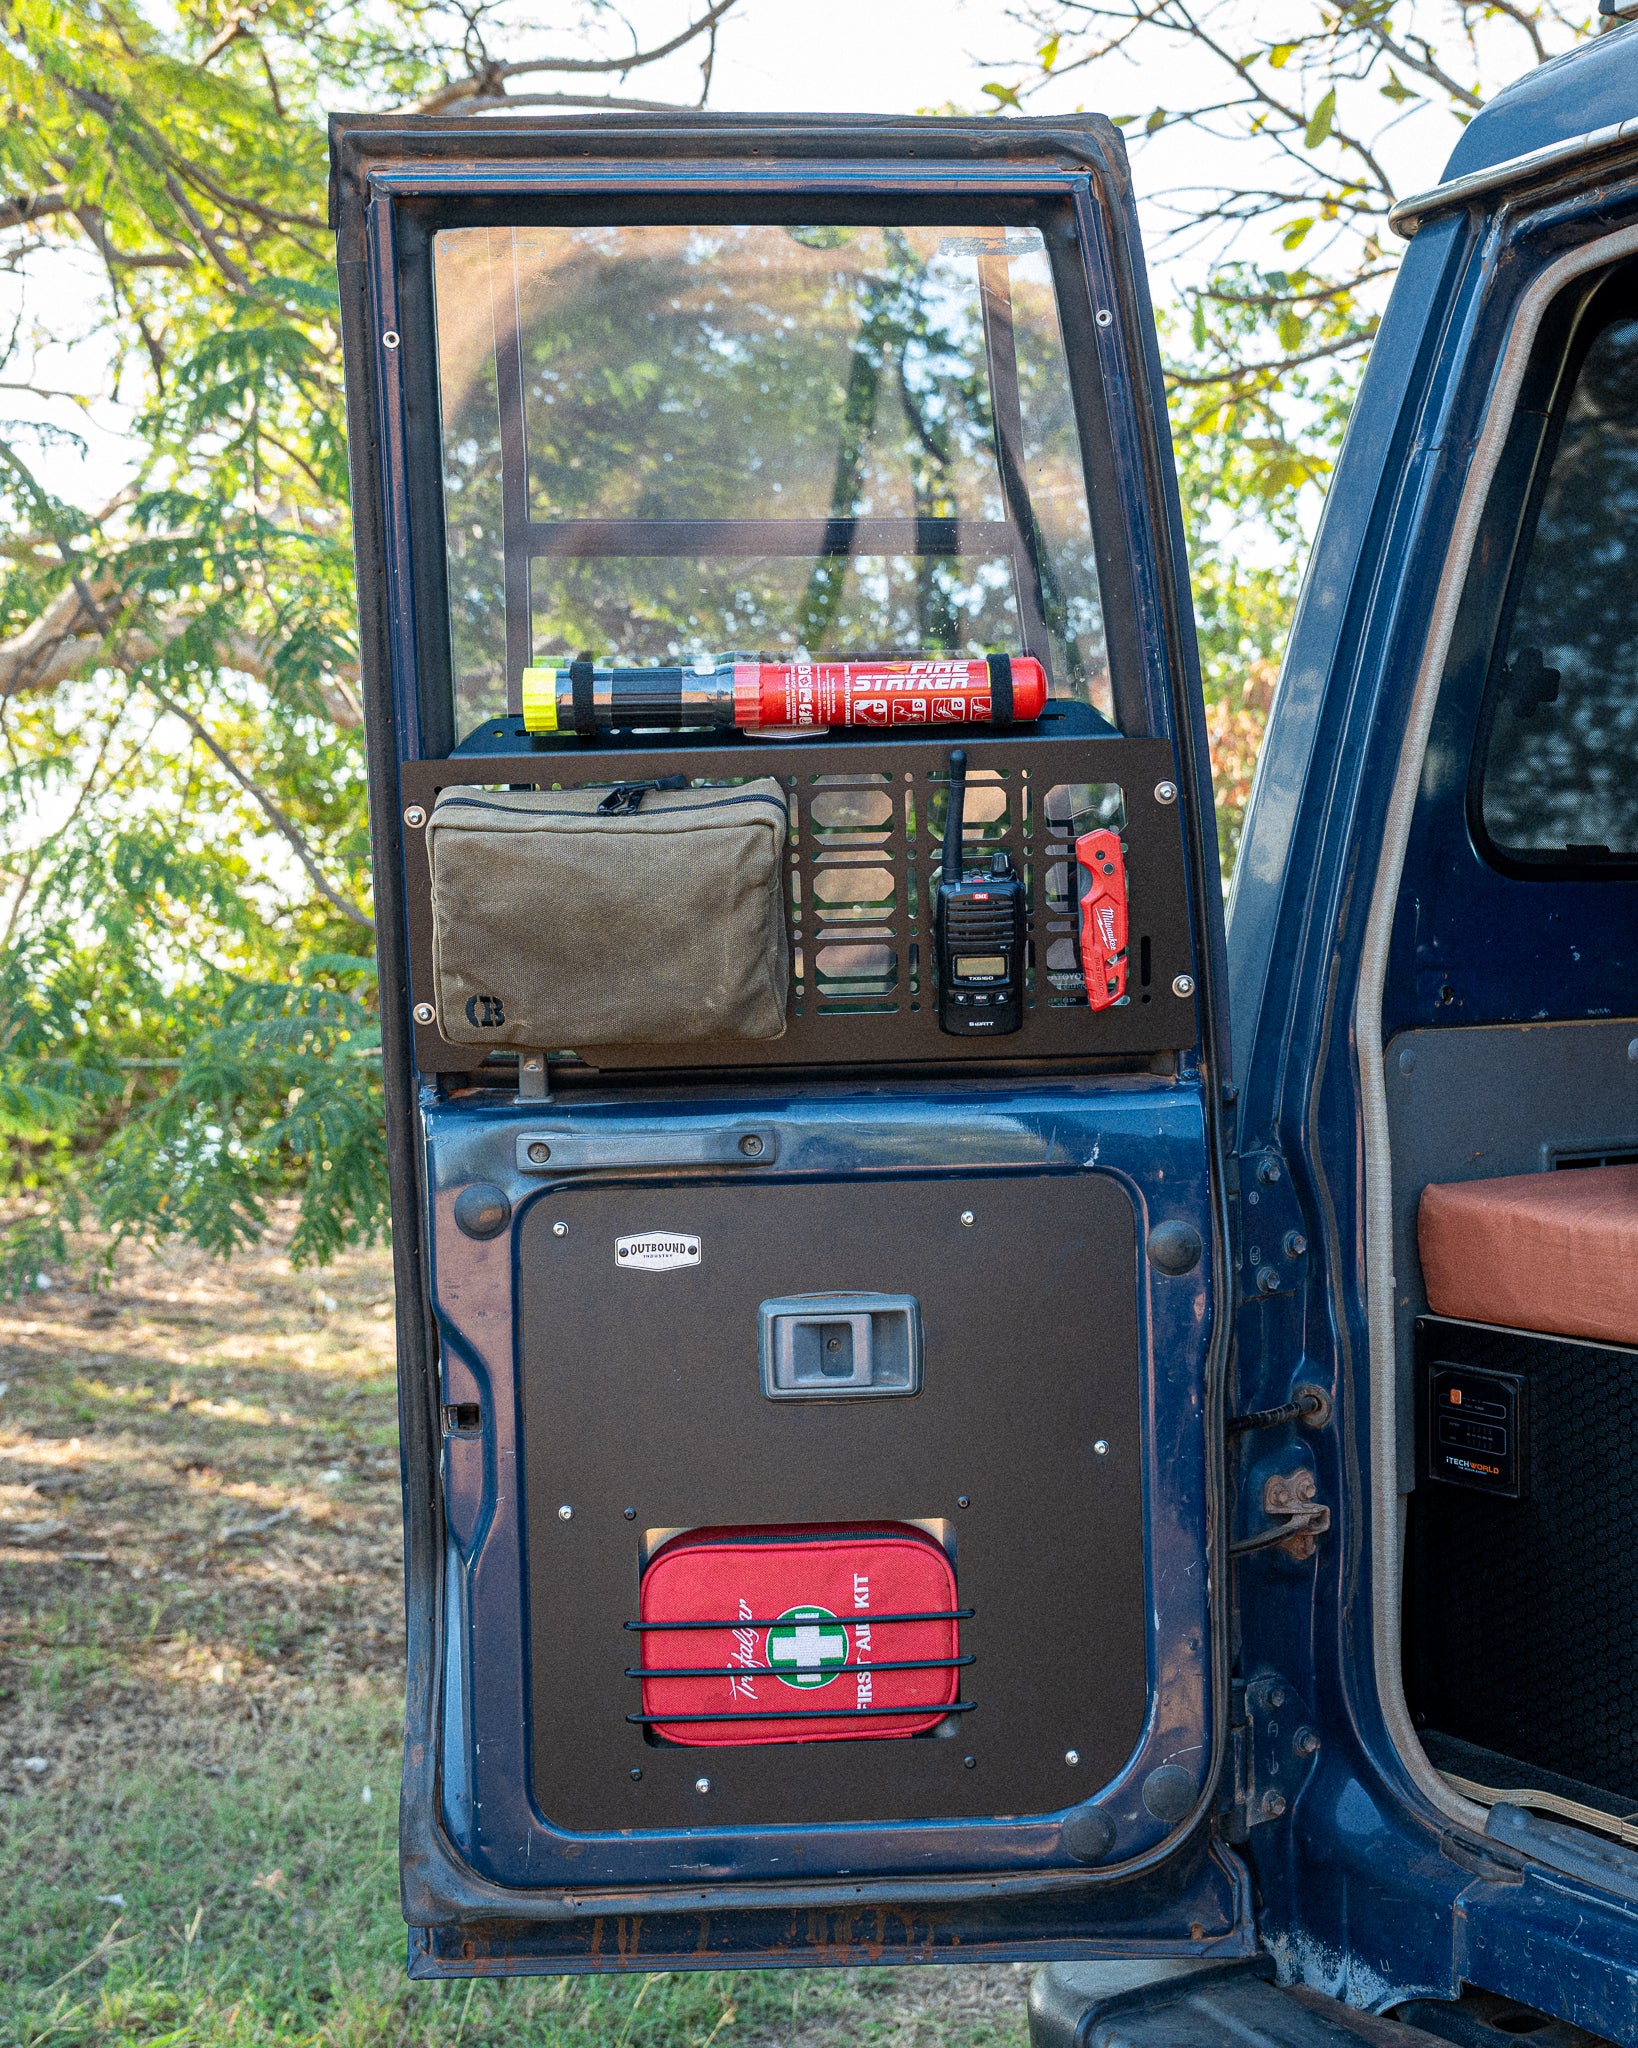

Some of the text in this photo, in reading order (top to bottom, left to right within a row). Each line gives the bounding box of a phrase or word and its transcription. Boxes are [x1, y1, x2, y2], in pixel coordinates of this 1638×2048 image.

[910, 661, 970, 673] FIRE
[853, 673, 970, 692] STRYKER
[1101, 906, 1118, 951] Milwaukee
[630, 1243, 686, 1255] OUTBOUND
[854, 1573, 870, 1609] KIT
